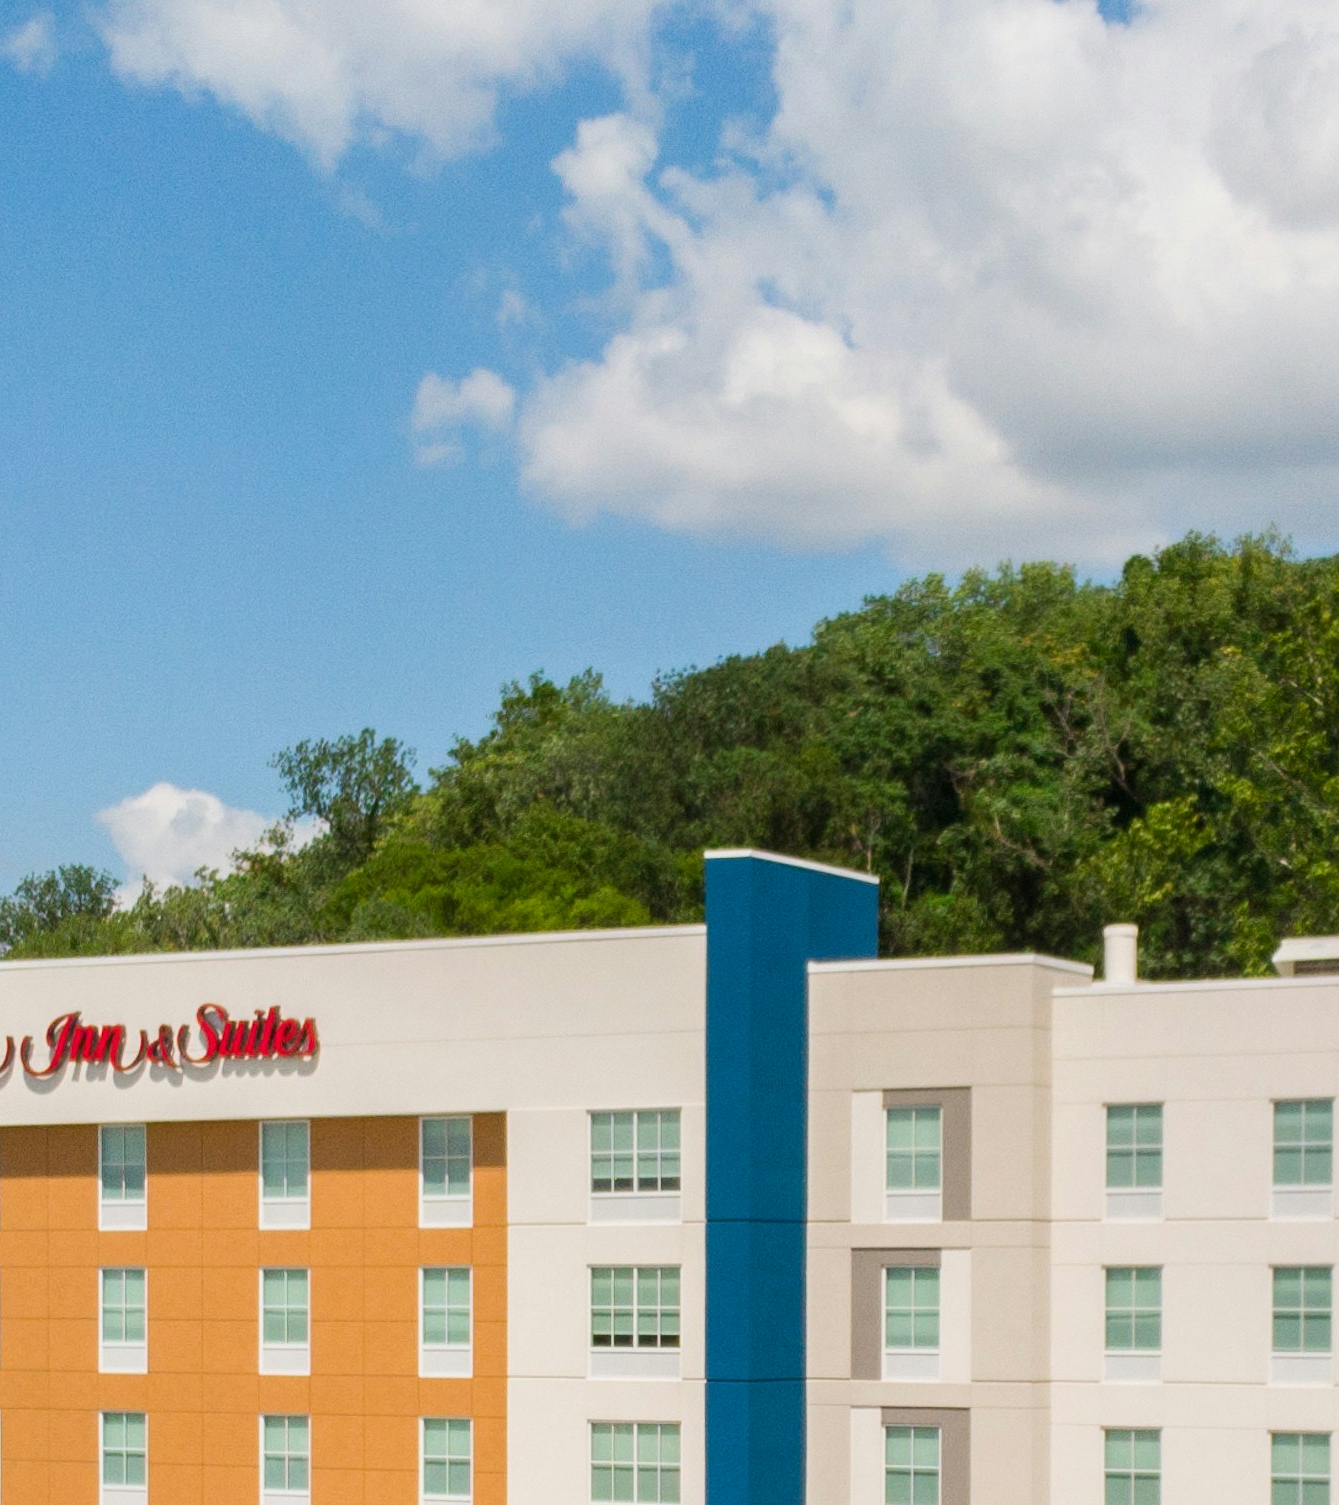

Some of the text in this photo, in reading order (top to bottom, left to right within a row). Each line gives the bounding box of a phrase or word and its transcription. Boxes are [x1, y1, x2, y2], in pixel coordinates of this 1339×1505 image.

[21, 1011, 147, 1077] Inn
[147, 1024, 179, 1069] &
[177, 1003, 319, 1063] Suites
